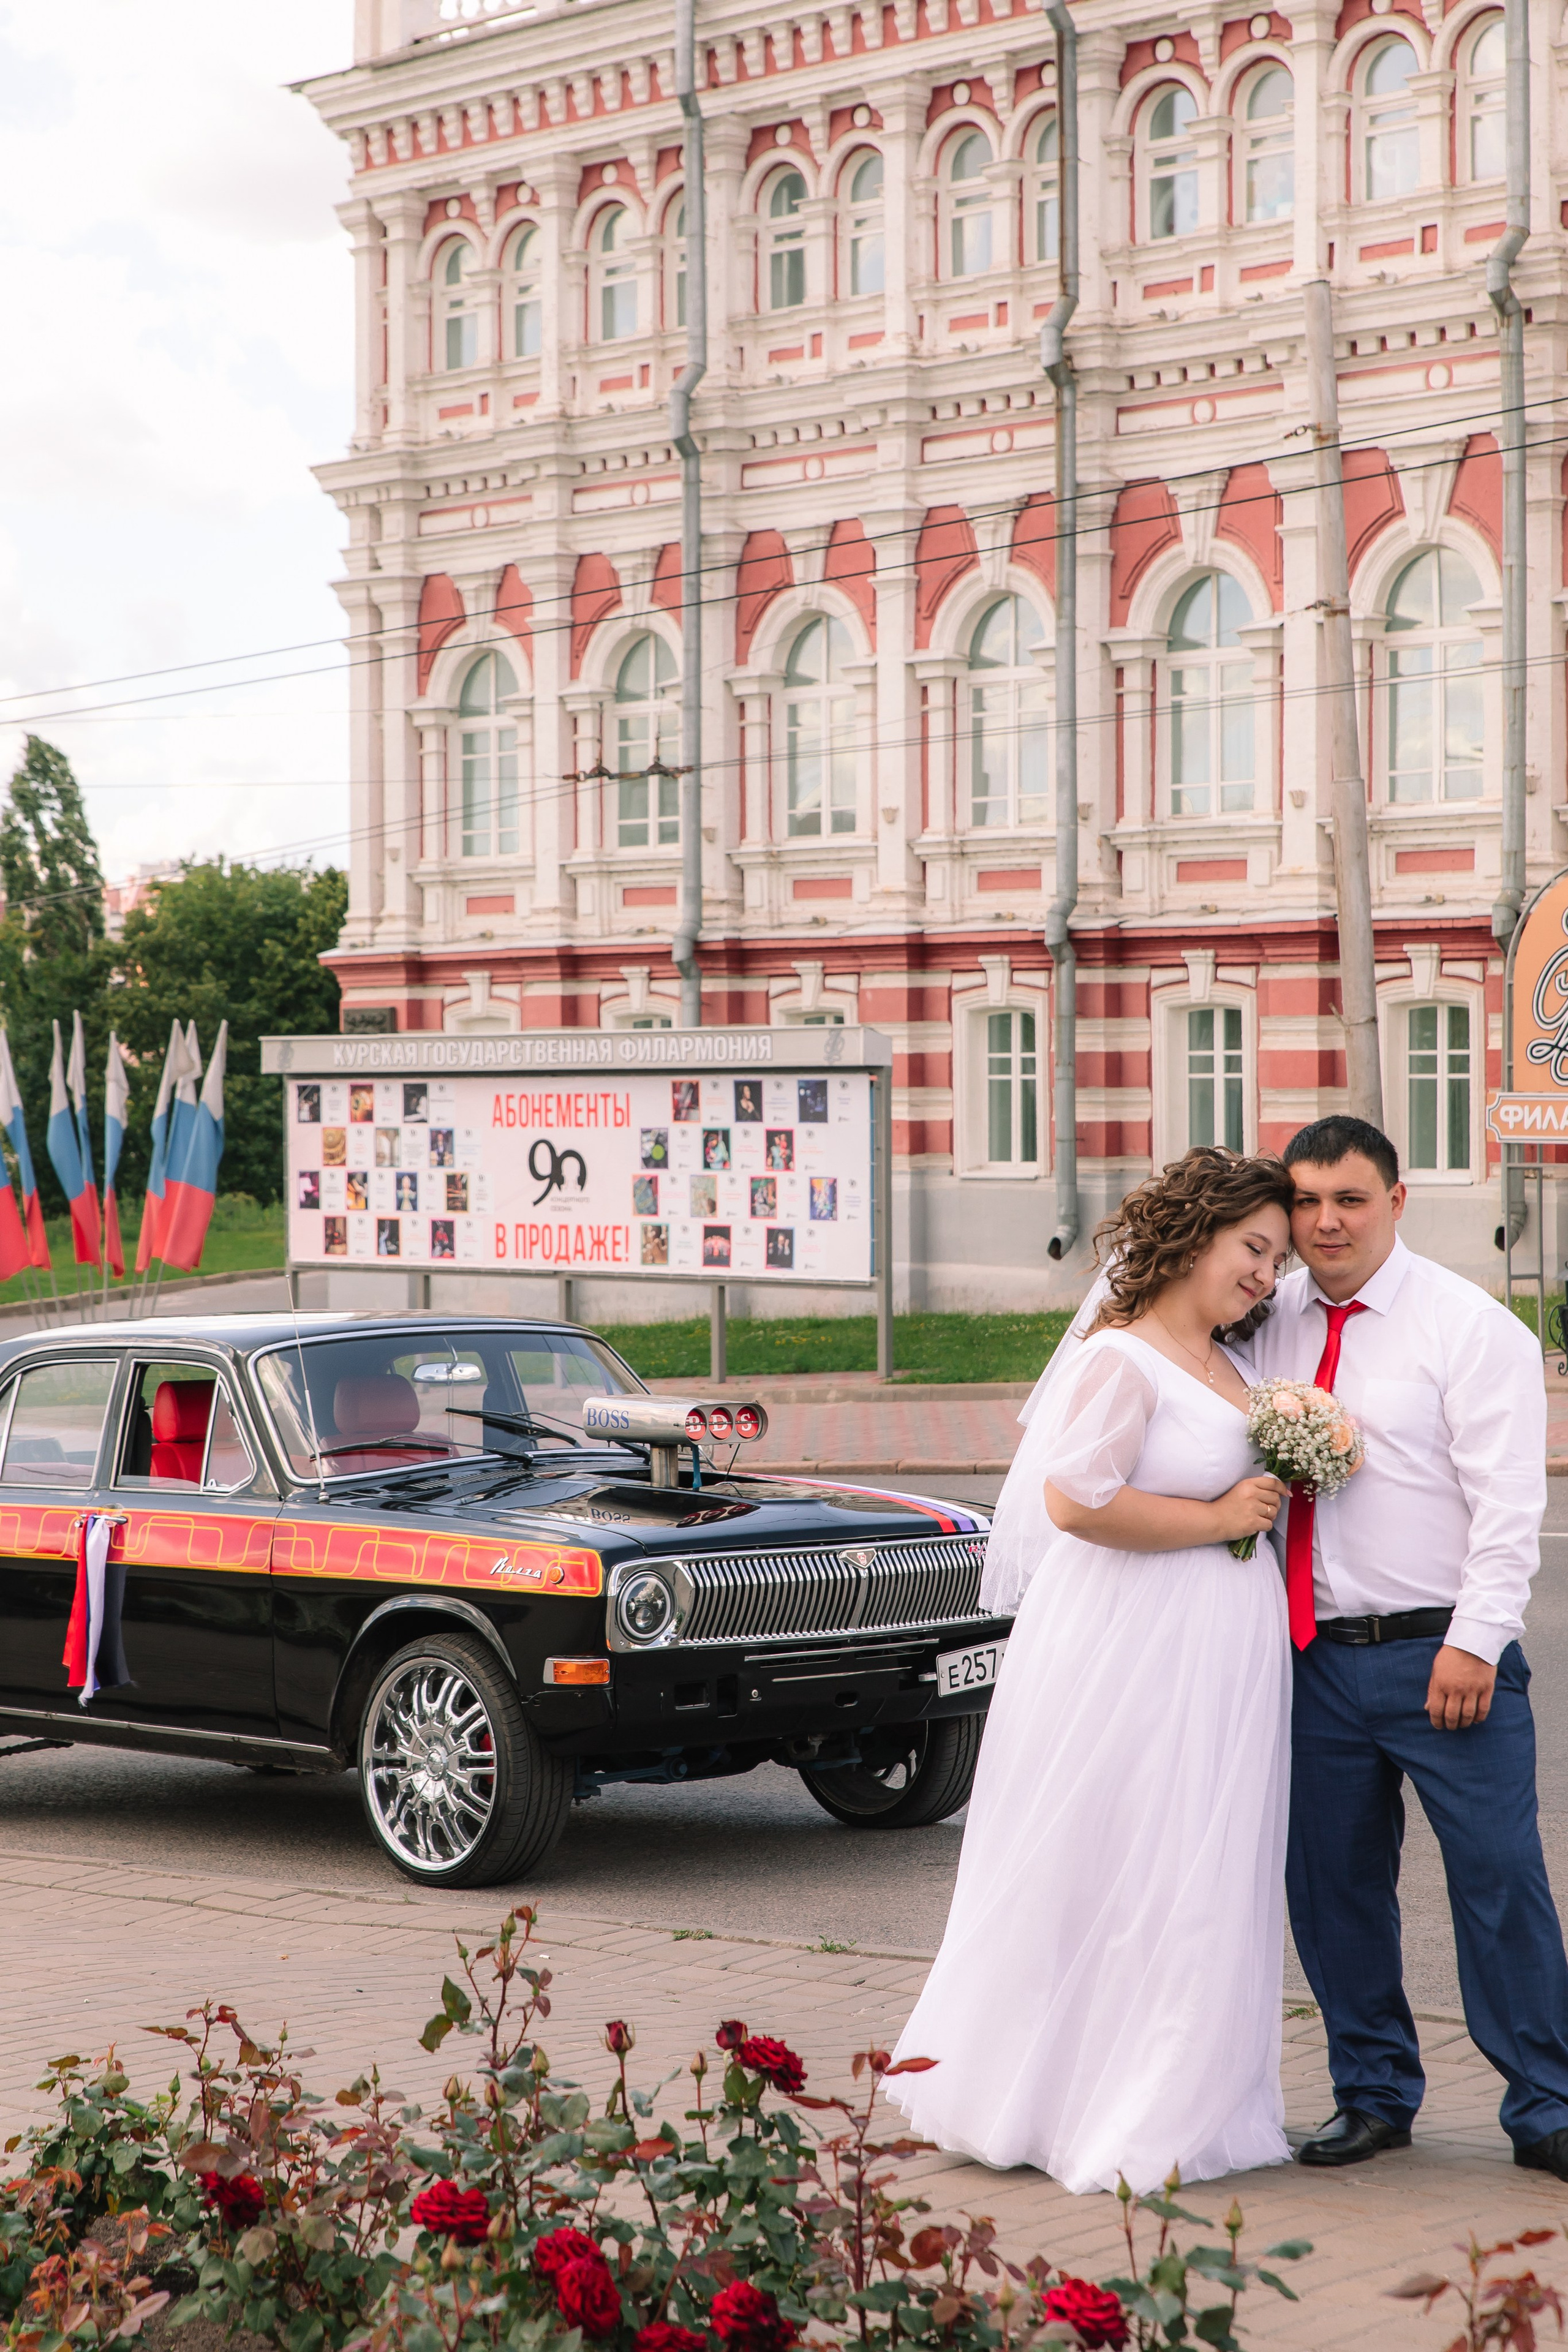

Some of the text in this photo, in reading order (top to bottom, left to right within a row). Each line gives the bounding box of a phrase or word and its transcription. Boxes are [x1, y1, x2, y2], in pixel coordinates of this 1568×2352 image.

[333, 1035, 772, 1068] КУРСКАЯ ГОСУДАРСТВЕННАЯ ФИЛАРМОНИЯ
[492, 1093, 631, 1128] АБОНЕМЕНТЫ
[496, 1223, 630, 1264] В ПРОДАЖЕ!
[587, 1408, 630, 1430] BOSS
